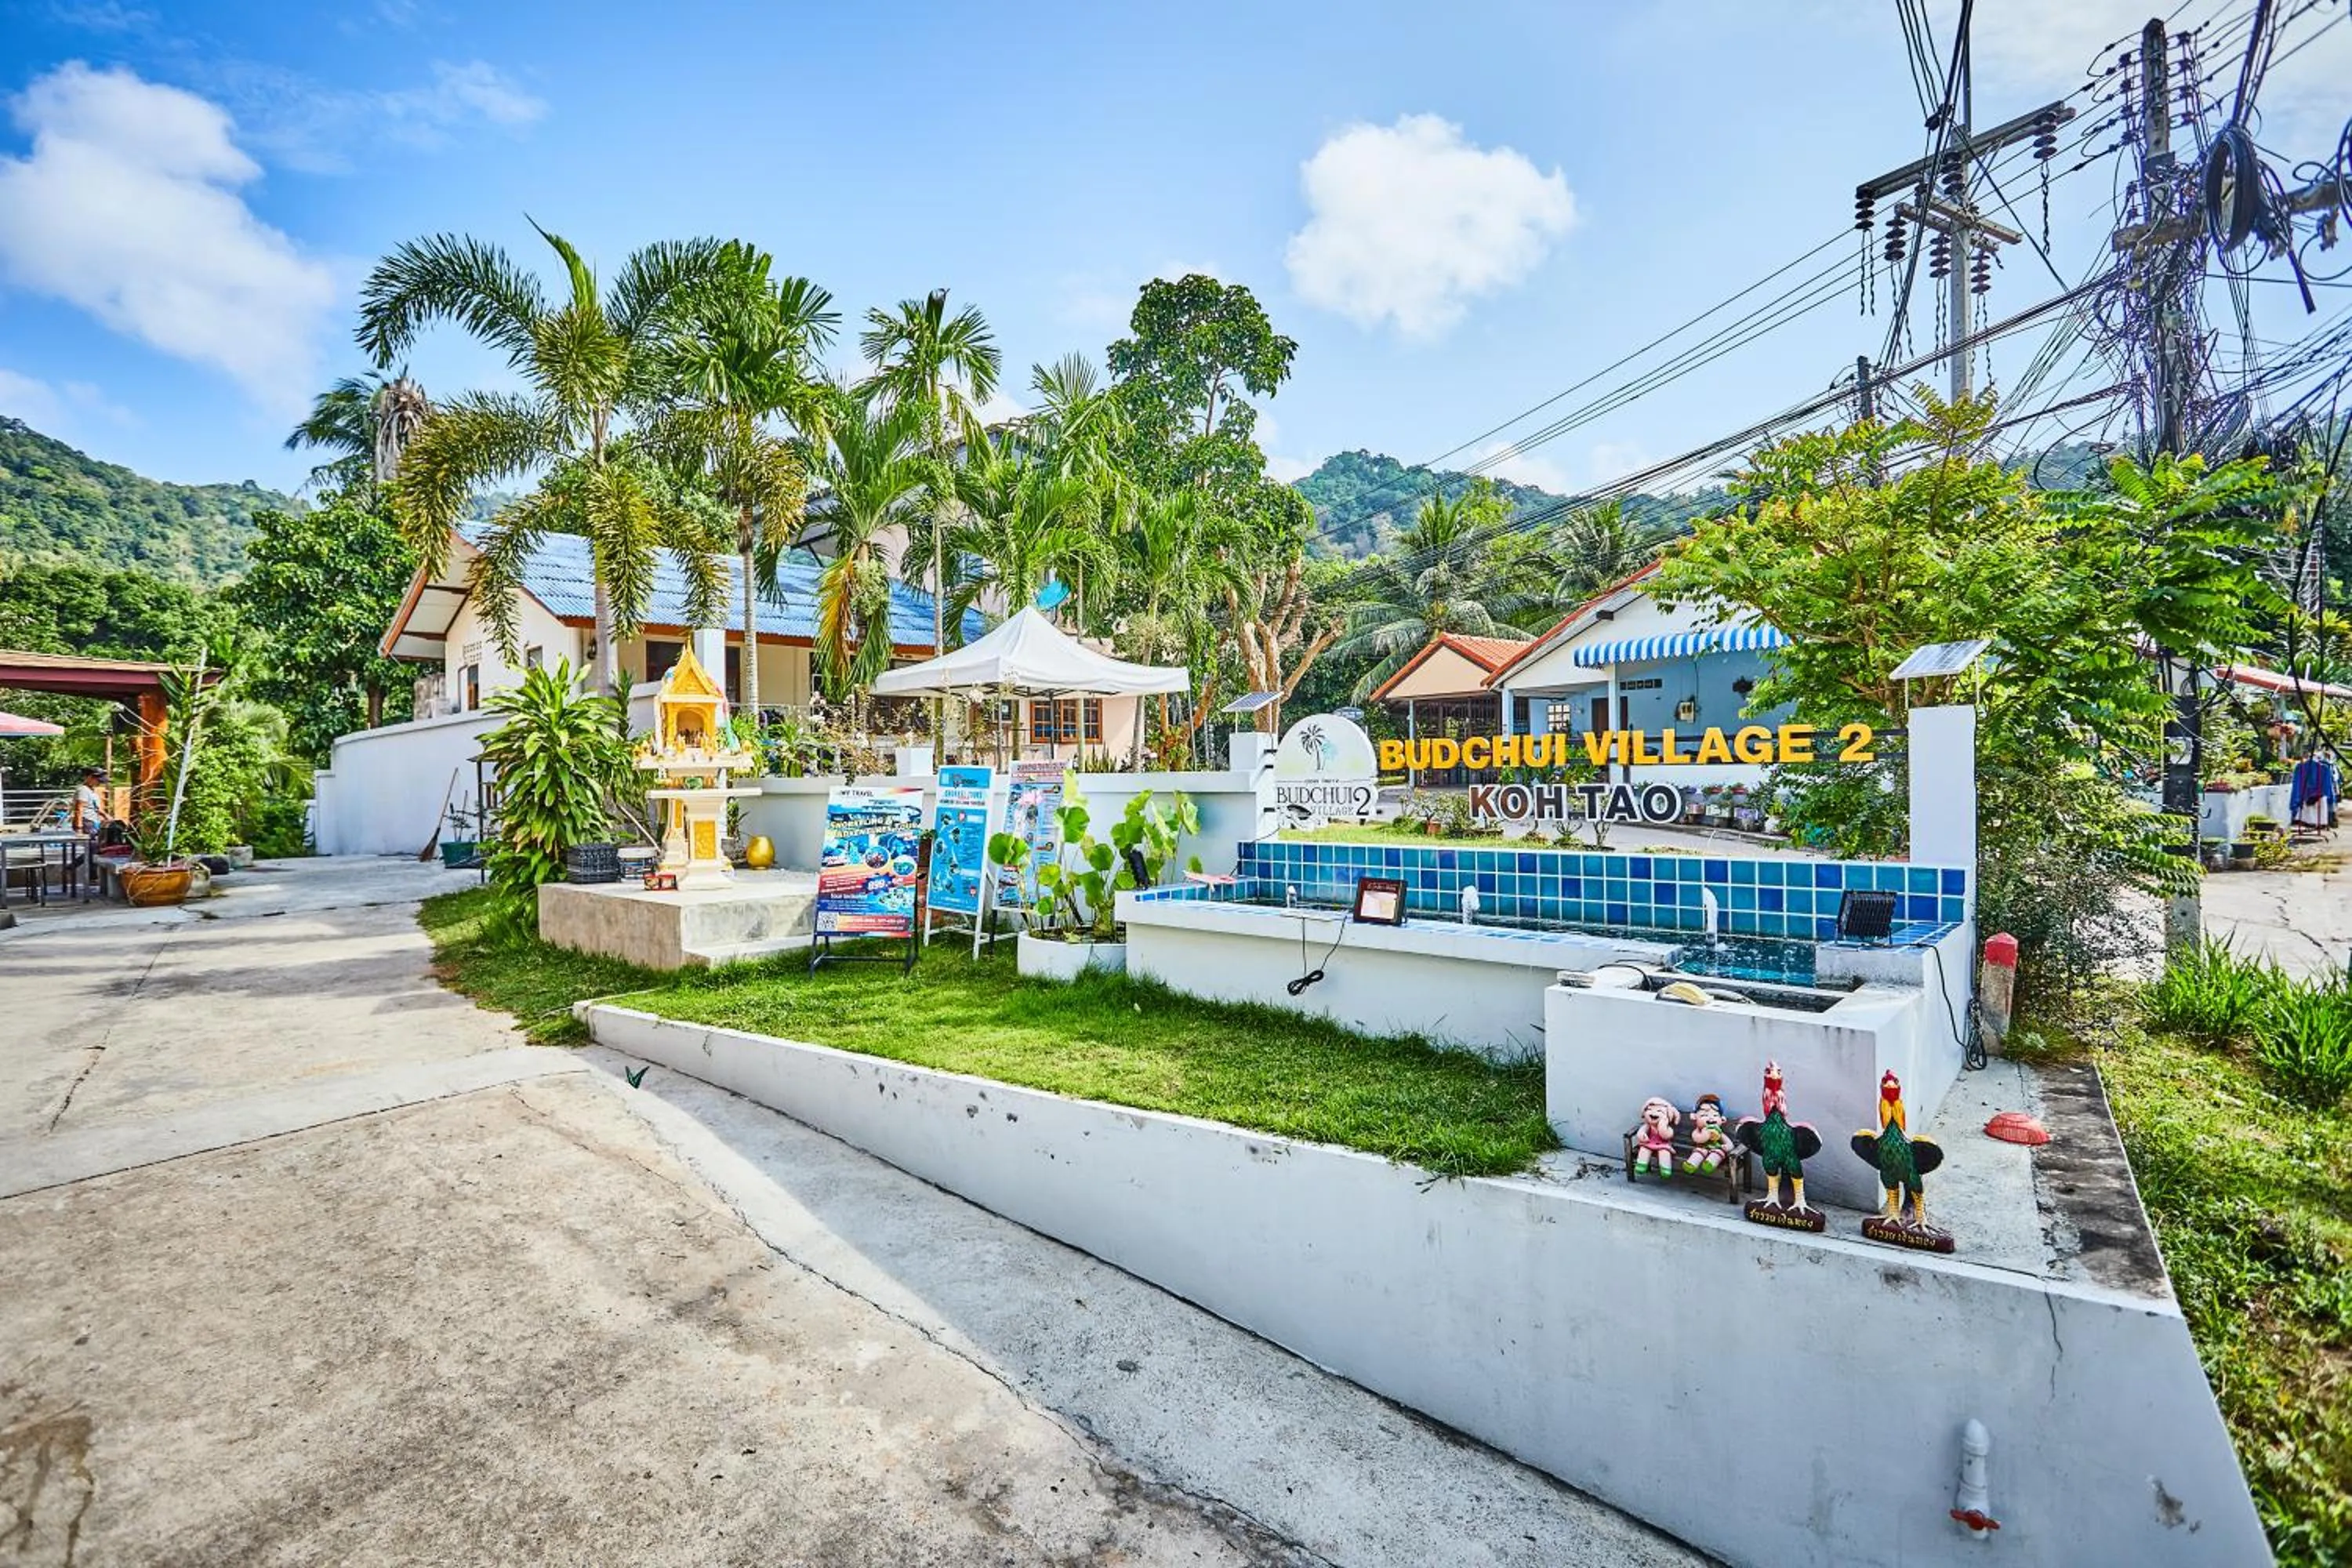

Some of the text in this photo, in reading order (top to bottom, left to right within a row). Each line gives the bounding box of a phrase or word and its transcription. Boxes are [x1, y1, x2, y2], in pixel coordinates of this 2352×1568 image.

[1379, 722, 1875, 771] BUDCHUI VILLAGE 2
[1276, 786, 1371, 815] BUDCHUI 2
[1310, 806, 1354, 816] VILLAGE
[1469, 783, 1682, 823] KOH TAO
